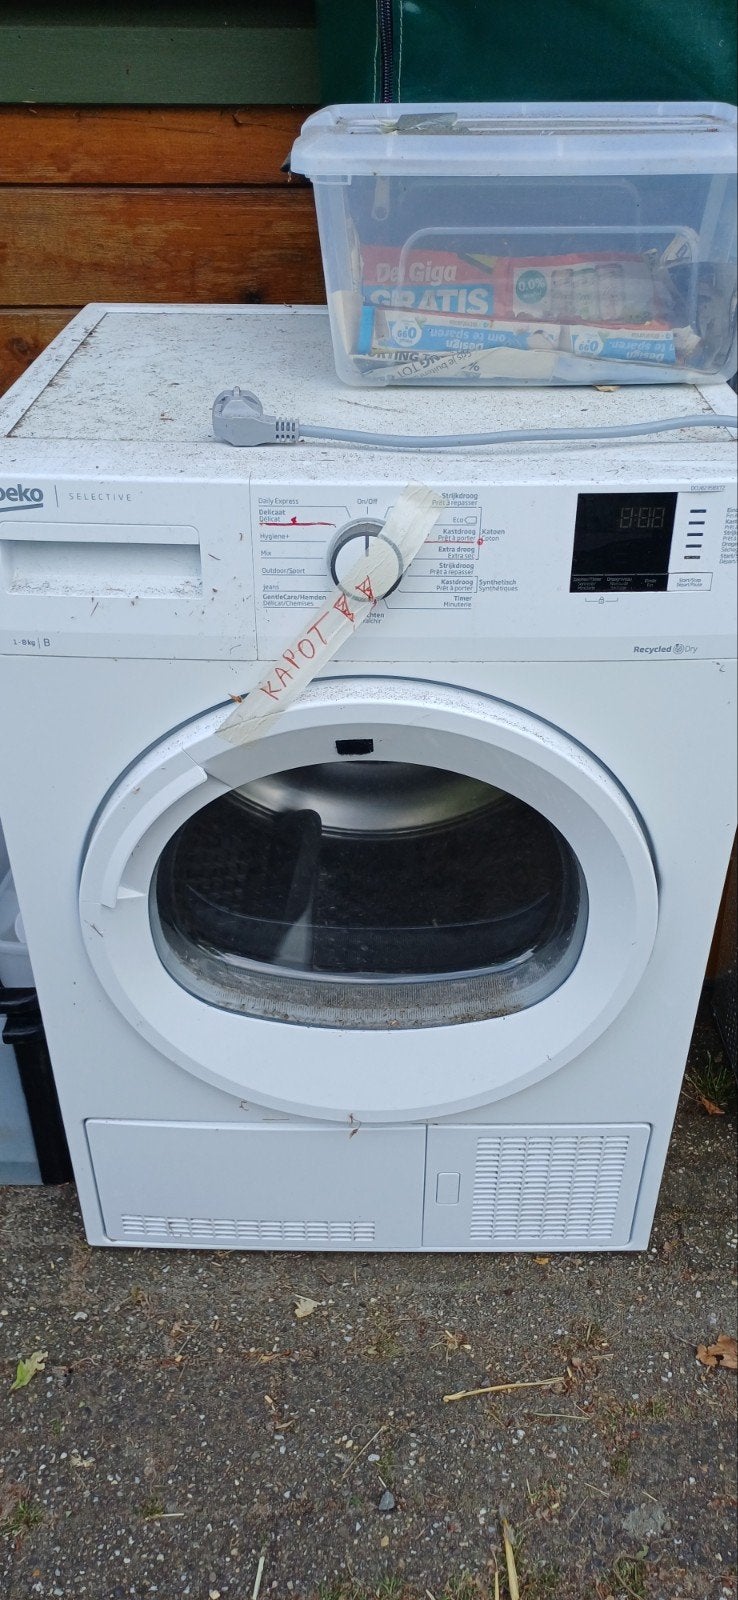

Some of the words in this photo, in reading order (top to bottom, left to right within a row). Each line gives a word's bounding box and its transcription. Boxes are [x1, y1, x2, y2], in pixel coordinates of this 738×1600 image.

[408, 260, 457, 287] Giga
[371, 288, 489, 315] GRATIS
[69, 492, 132, 502] SELECTIVE
[441, 492, 478, 500] Strijkdroog
[258, 498, 273, 506] Daily
[275, 497, 299, 506] Express
[443, 528, 476, 536] Kastdroog
[260, 533, 289, 541] Hygiene+
[438, 545, 455, 553] Extra
[456, 545, 475, 553] droog
[439, 561, 475, 570] Strijkdroog
[261, 567, 305, 575] Outdoor/Sport
[440, 578, 474, 586] Kastdroog
[479, 578, 517, 586] Synthetisch
[262, 593, 327, 601] GentleCare/Hemden
[43, 638, 51, 647] B
[633, 645, 672, 655] Recycled
[684, 645, 698, 654] Dry
[260, 611, 330, 701] KAPOT
